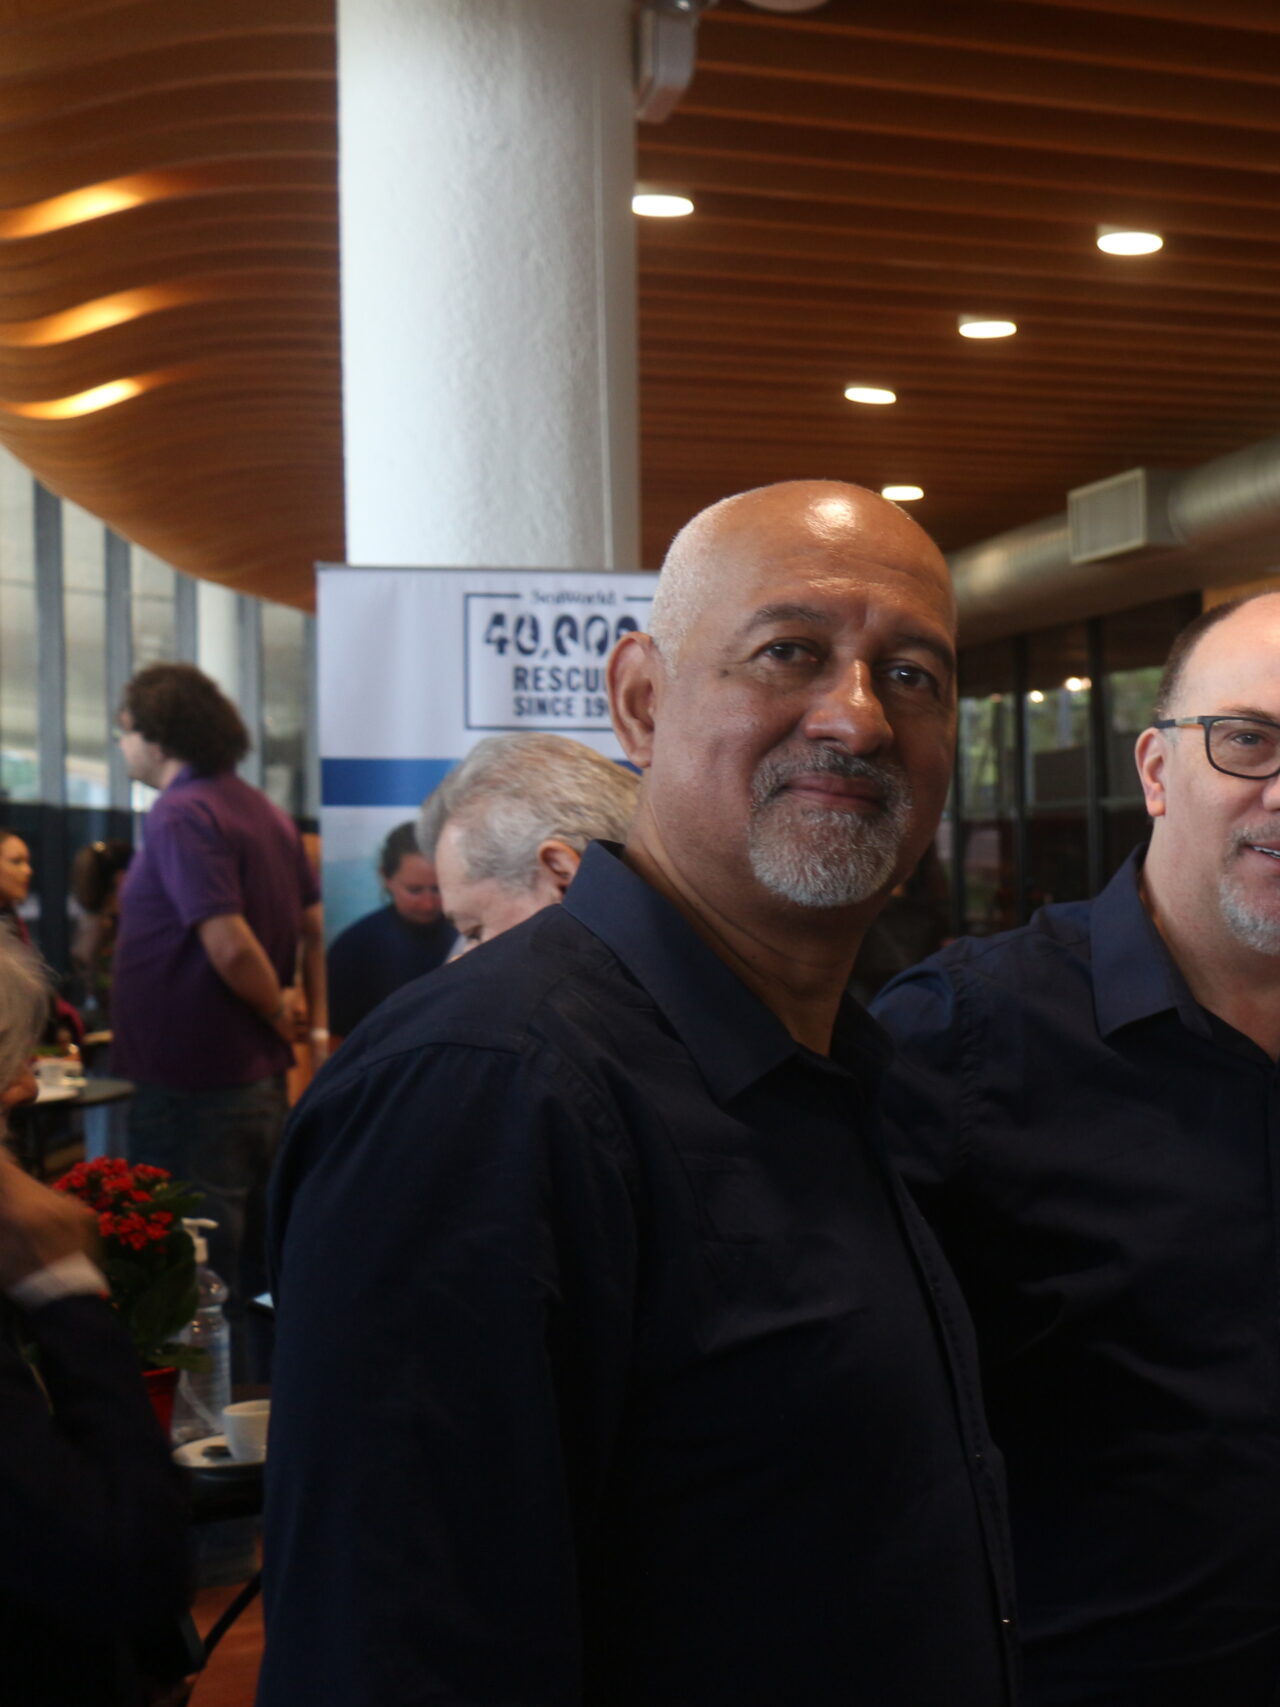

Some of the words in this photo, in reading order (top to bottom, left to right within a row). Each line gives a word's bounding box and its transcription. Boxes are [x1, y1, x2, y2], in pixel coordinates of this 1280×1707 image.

[513, 666, 607, 692] RESCU
[513, 697, 575, 716] SINCE
[584, 699, 609, 717] 19
